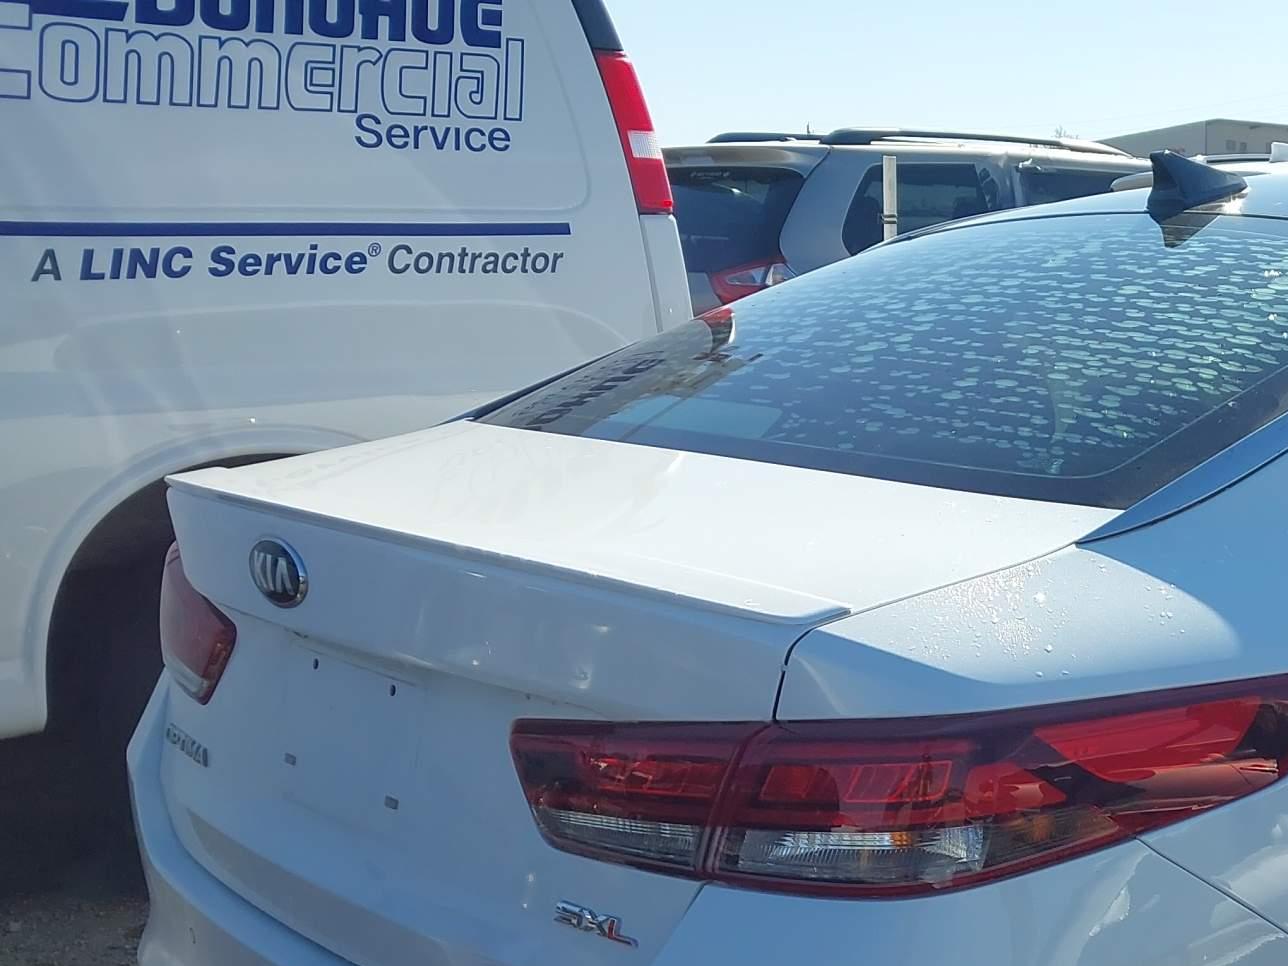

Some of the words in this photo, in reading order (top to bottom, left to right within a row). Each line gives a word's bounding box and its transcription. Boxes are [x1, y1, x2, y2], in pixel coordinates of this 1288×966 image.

[354, 113, 511, 152] Service
[30, 248, 62, 282] A
[79, 246, 193, 281] LINC
[387, 244, 565, 275] Contractor
[553, 899, 639, 948] SXL
